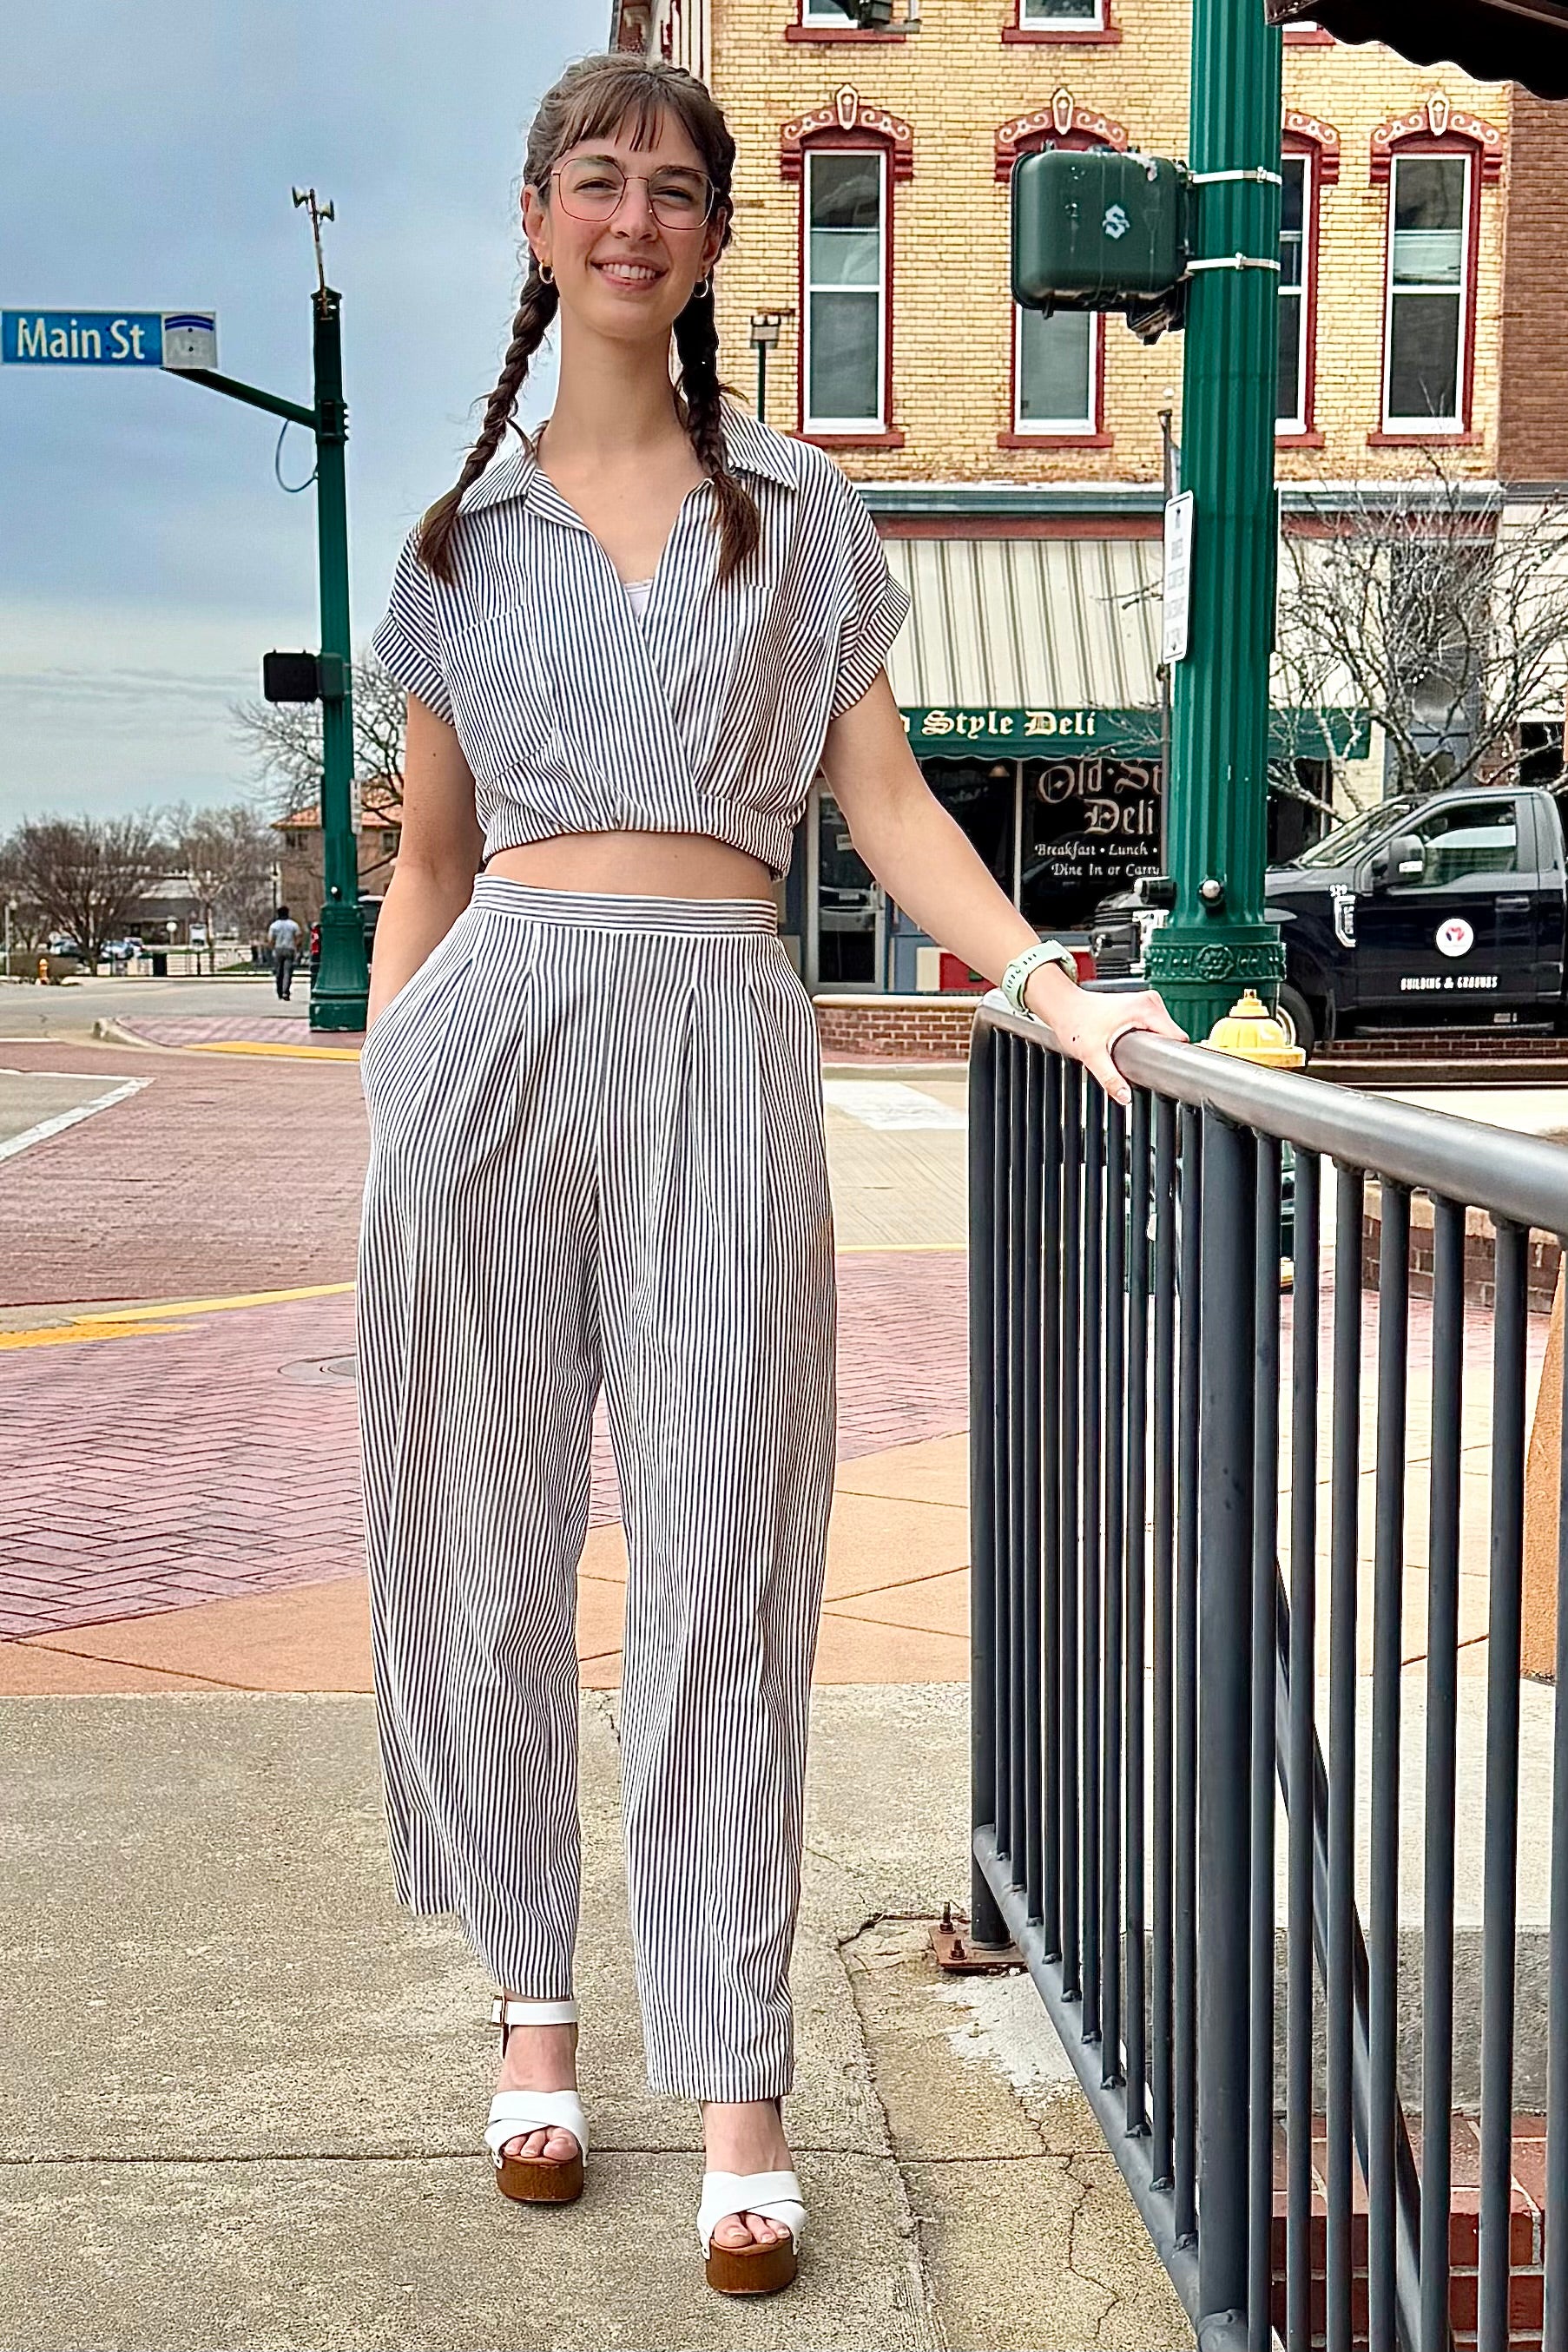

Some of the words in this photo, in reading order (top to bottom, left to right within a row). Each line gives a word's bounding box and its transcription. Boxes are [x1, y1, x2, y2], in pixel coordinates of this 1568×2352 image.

[17, 317, 102, 358] Main
[110, 320, 146, 359] St
[921, 710, 1013, 739] Style
[1024, 710, 1096, 736] Deli
[1038, 758, 1102, 803] Old
[1083, 799, 1154, 834] Deli
[1034, 841, 1096, 860] Breakfast
[1109, 841, 1148, 856] Lunch
[1051, 862, 1083, 876] Dine
[1089, 863, 1103, 876] In
[1108, 866, 1121, 876] or
